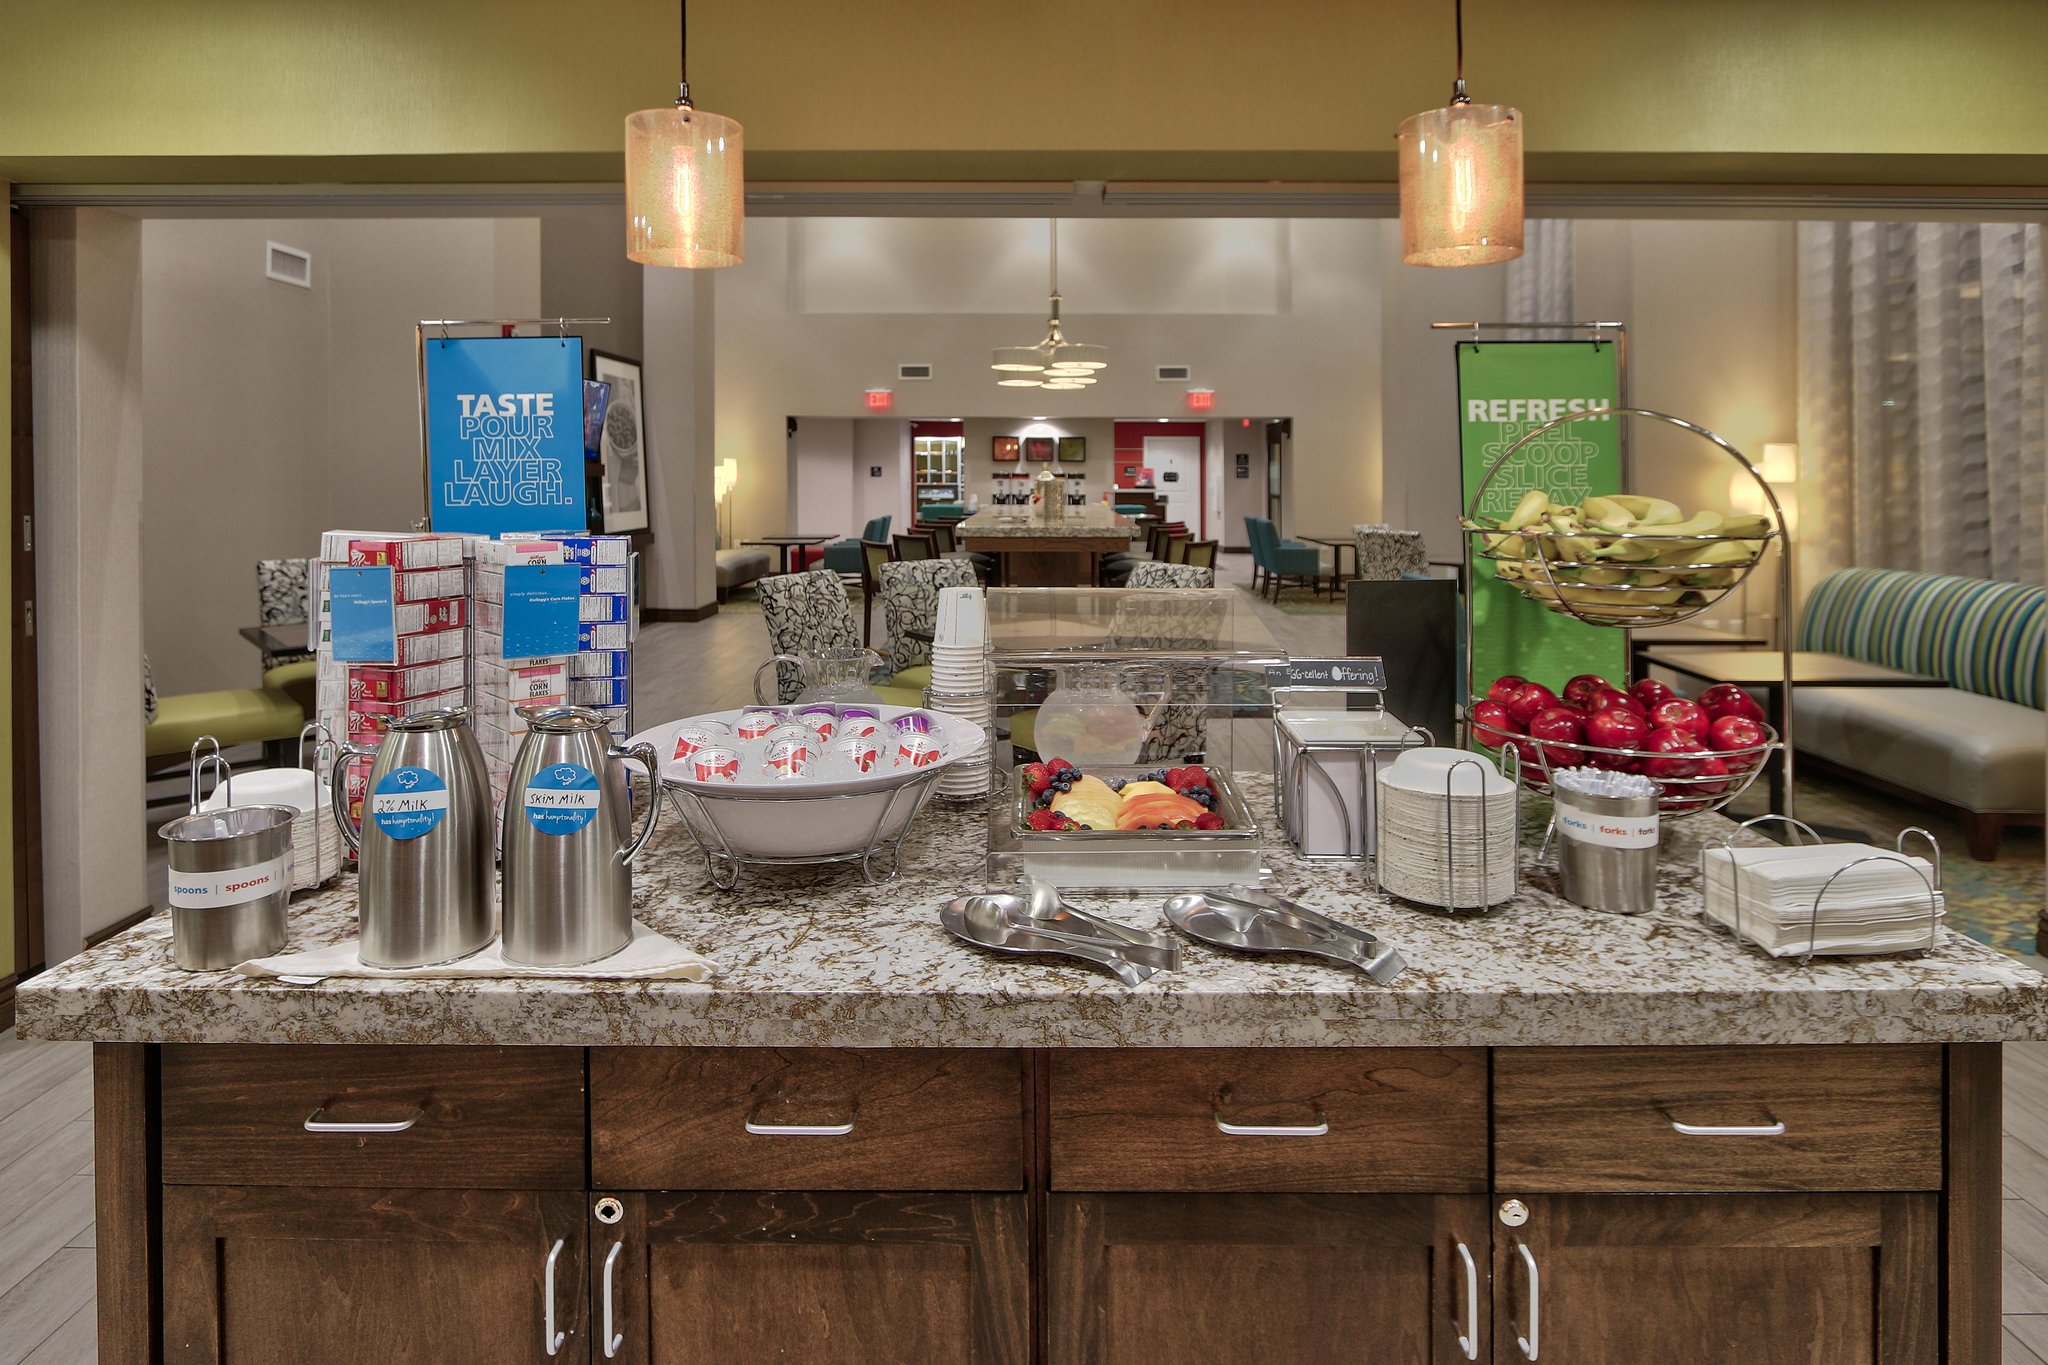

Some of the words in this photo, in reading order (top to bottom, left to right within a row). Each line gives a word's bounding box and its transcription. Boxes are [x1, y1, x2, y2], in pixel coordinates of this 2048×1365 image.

[456, 394, 554, 417] TASTE
[870, 392, 888, 406] EXIT
[1193, 392, 1211, 406] EXIT
[1468, 399, 1610, 422] REFRESH
[460, 415, 554, 439] POUR
[1500, 420, 1581, 444] PEEL
[473, 436, 541, 461] MIX
[1482, 441, 1600, 467] SCOOP
[454, 458, 562, 483] LAYER
[1495, 464, 1588, 489] SLICE
[444, 481, 573, 507] LAUGH.
[1481, 486, 1593, 513] REAX
[529, 658, 549, 667] FLAKES
[1268, 668, 1282, 677] An
[529, 682, 549, 691] CORN
[529, 689, 549, 698] FLAKES
[378, 799, 396, 814] 2%
[392, 812, 435, 828] hamptonality!
[533, 812, 544, 820] has
[545, 810, 587, 825] hamptonality!
[1563, 816, 1588, 830] forks
[1599, 825, 1628, 836] forks
[174, 885, 209, 895] spoons
[225, 875, 270, 892] spoons
